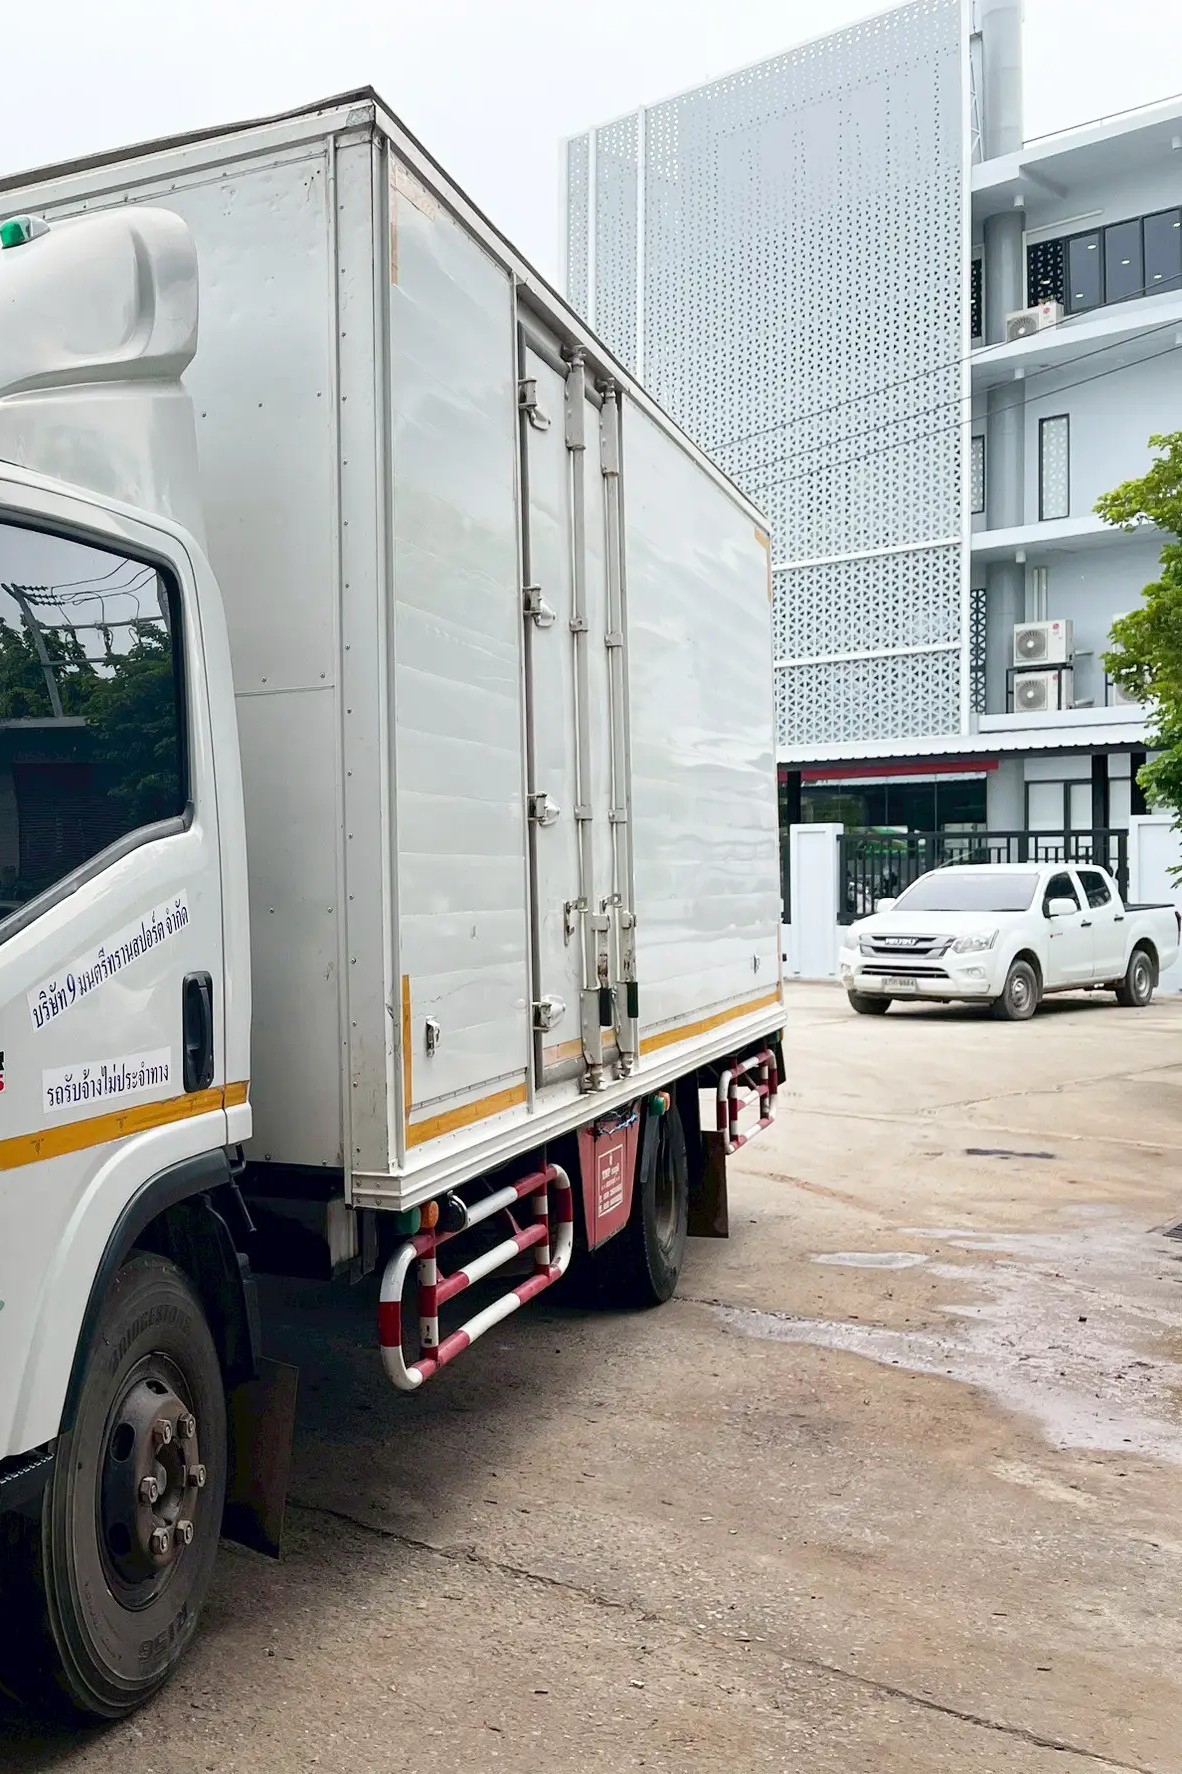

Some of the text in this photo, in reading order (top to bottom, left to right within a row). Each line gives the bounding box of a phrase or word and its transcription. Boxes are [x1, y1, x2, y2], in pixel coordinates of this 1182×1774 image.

[166, 898, 189, 935] จำกัด
[47, 1061, 169, 1107] รถรับจ้างไม่ประจำทาง
